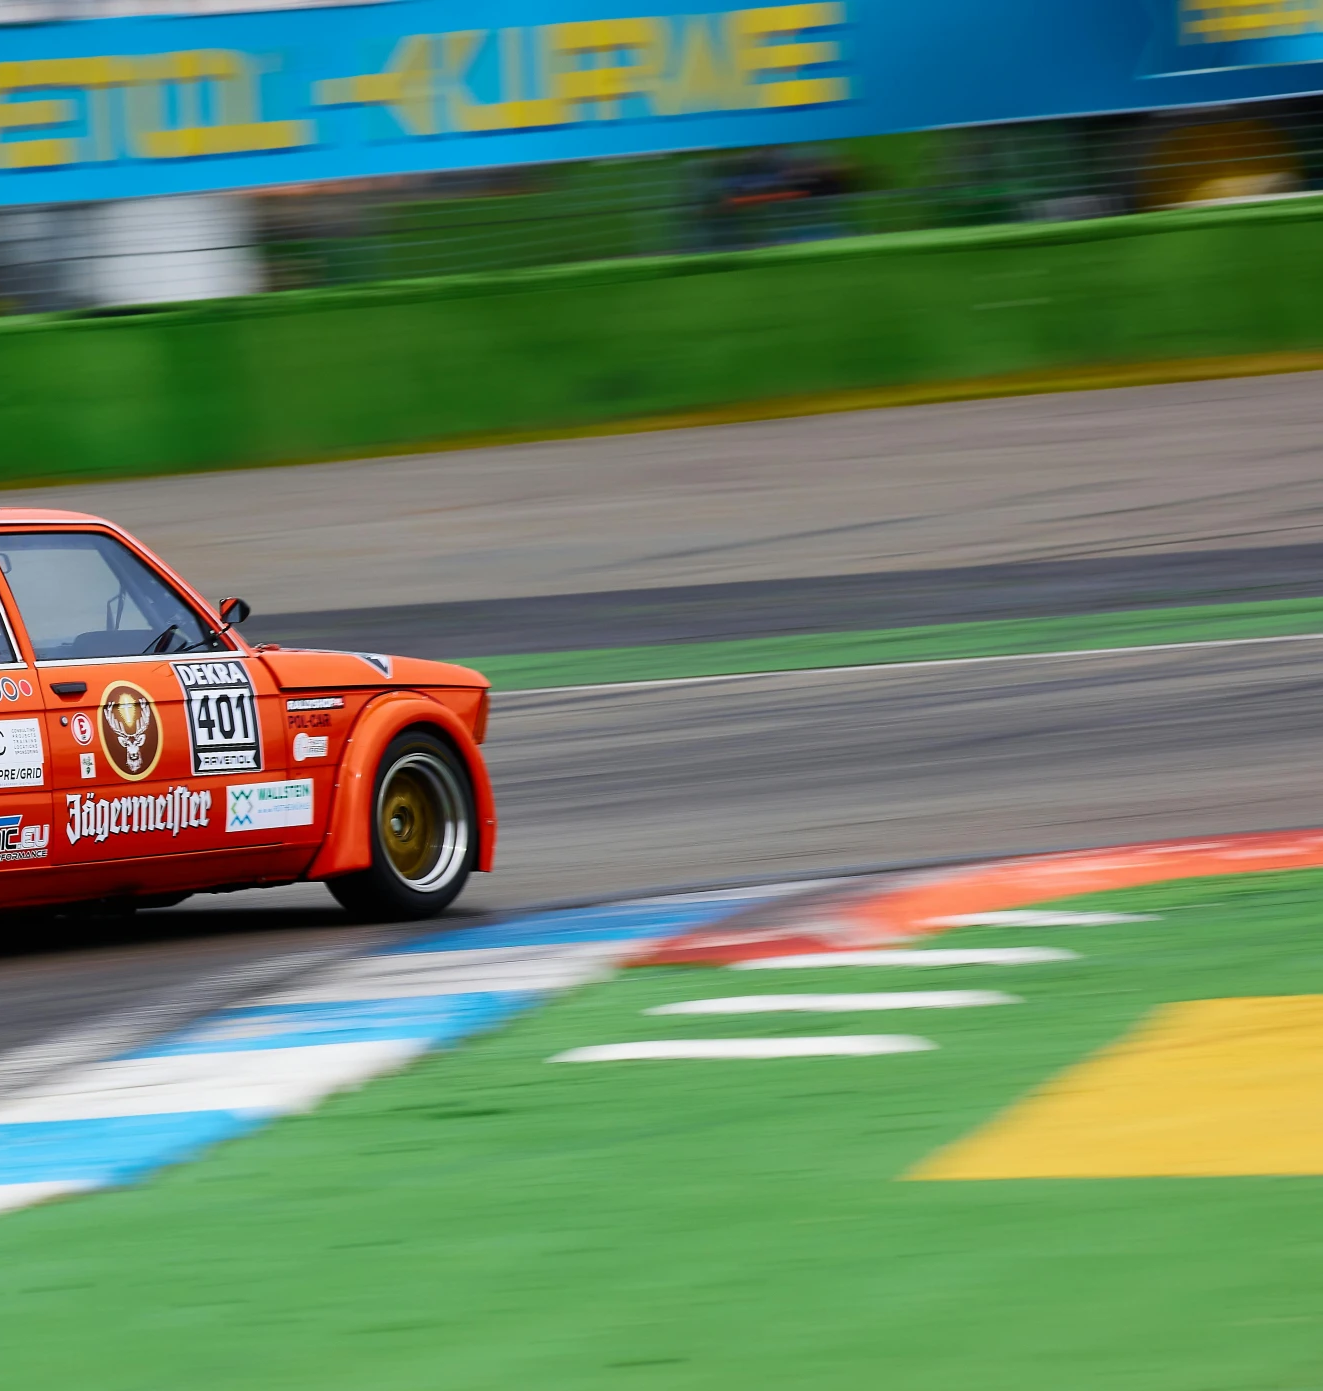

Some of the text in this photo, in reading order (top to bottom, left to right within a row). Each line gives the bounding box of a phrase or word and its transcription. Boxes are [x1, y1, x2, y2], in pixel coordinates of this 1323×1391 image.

[176, 663, 249, 686] DEKRA
[198, 694, 249, 740] 401
[288, 714, 332, 729] POL-CAR
